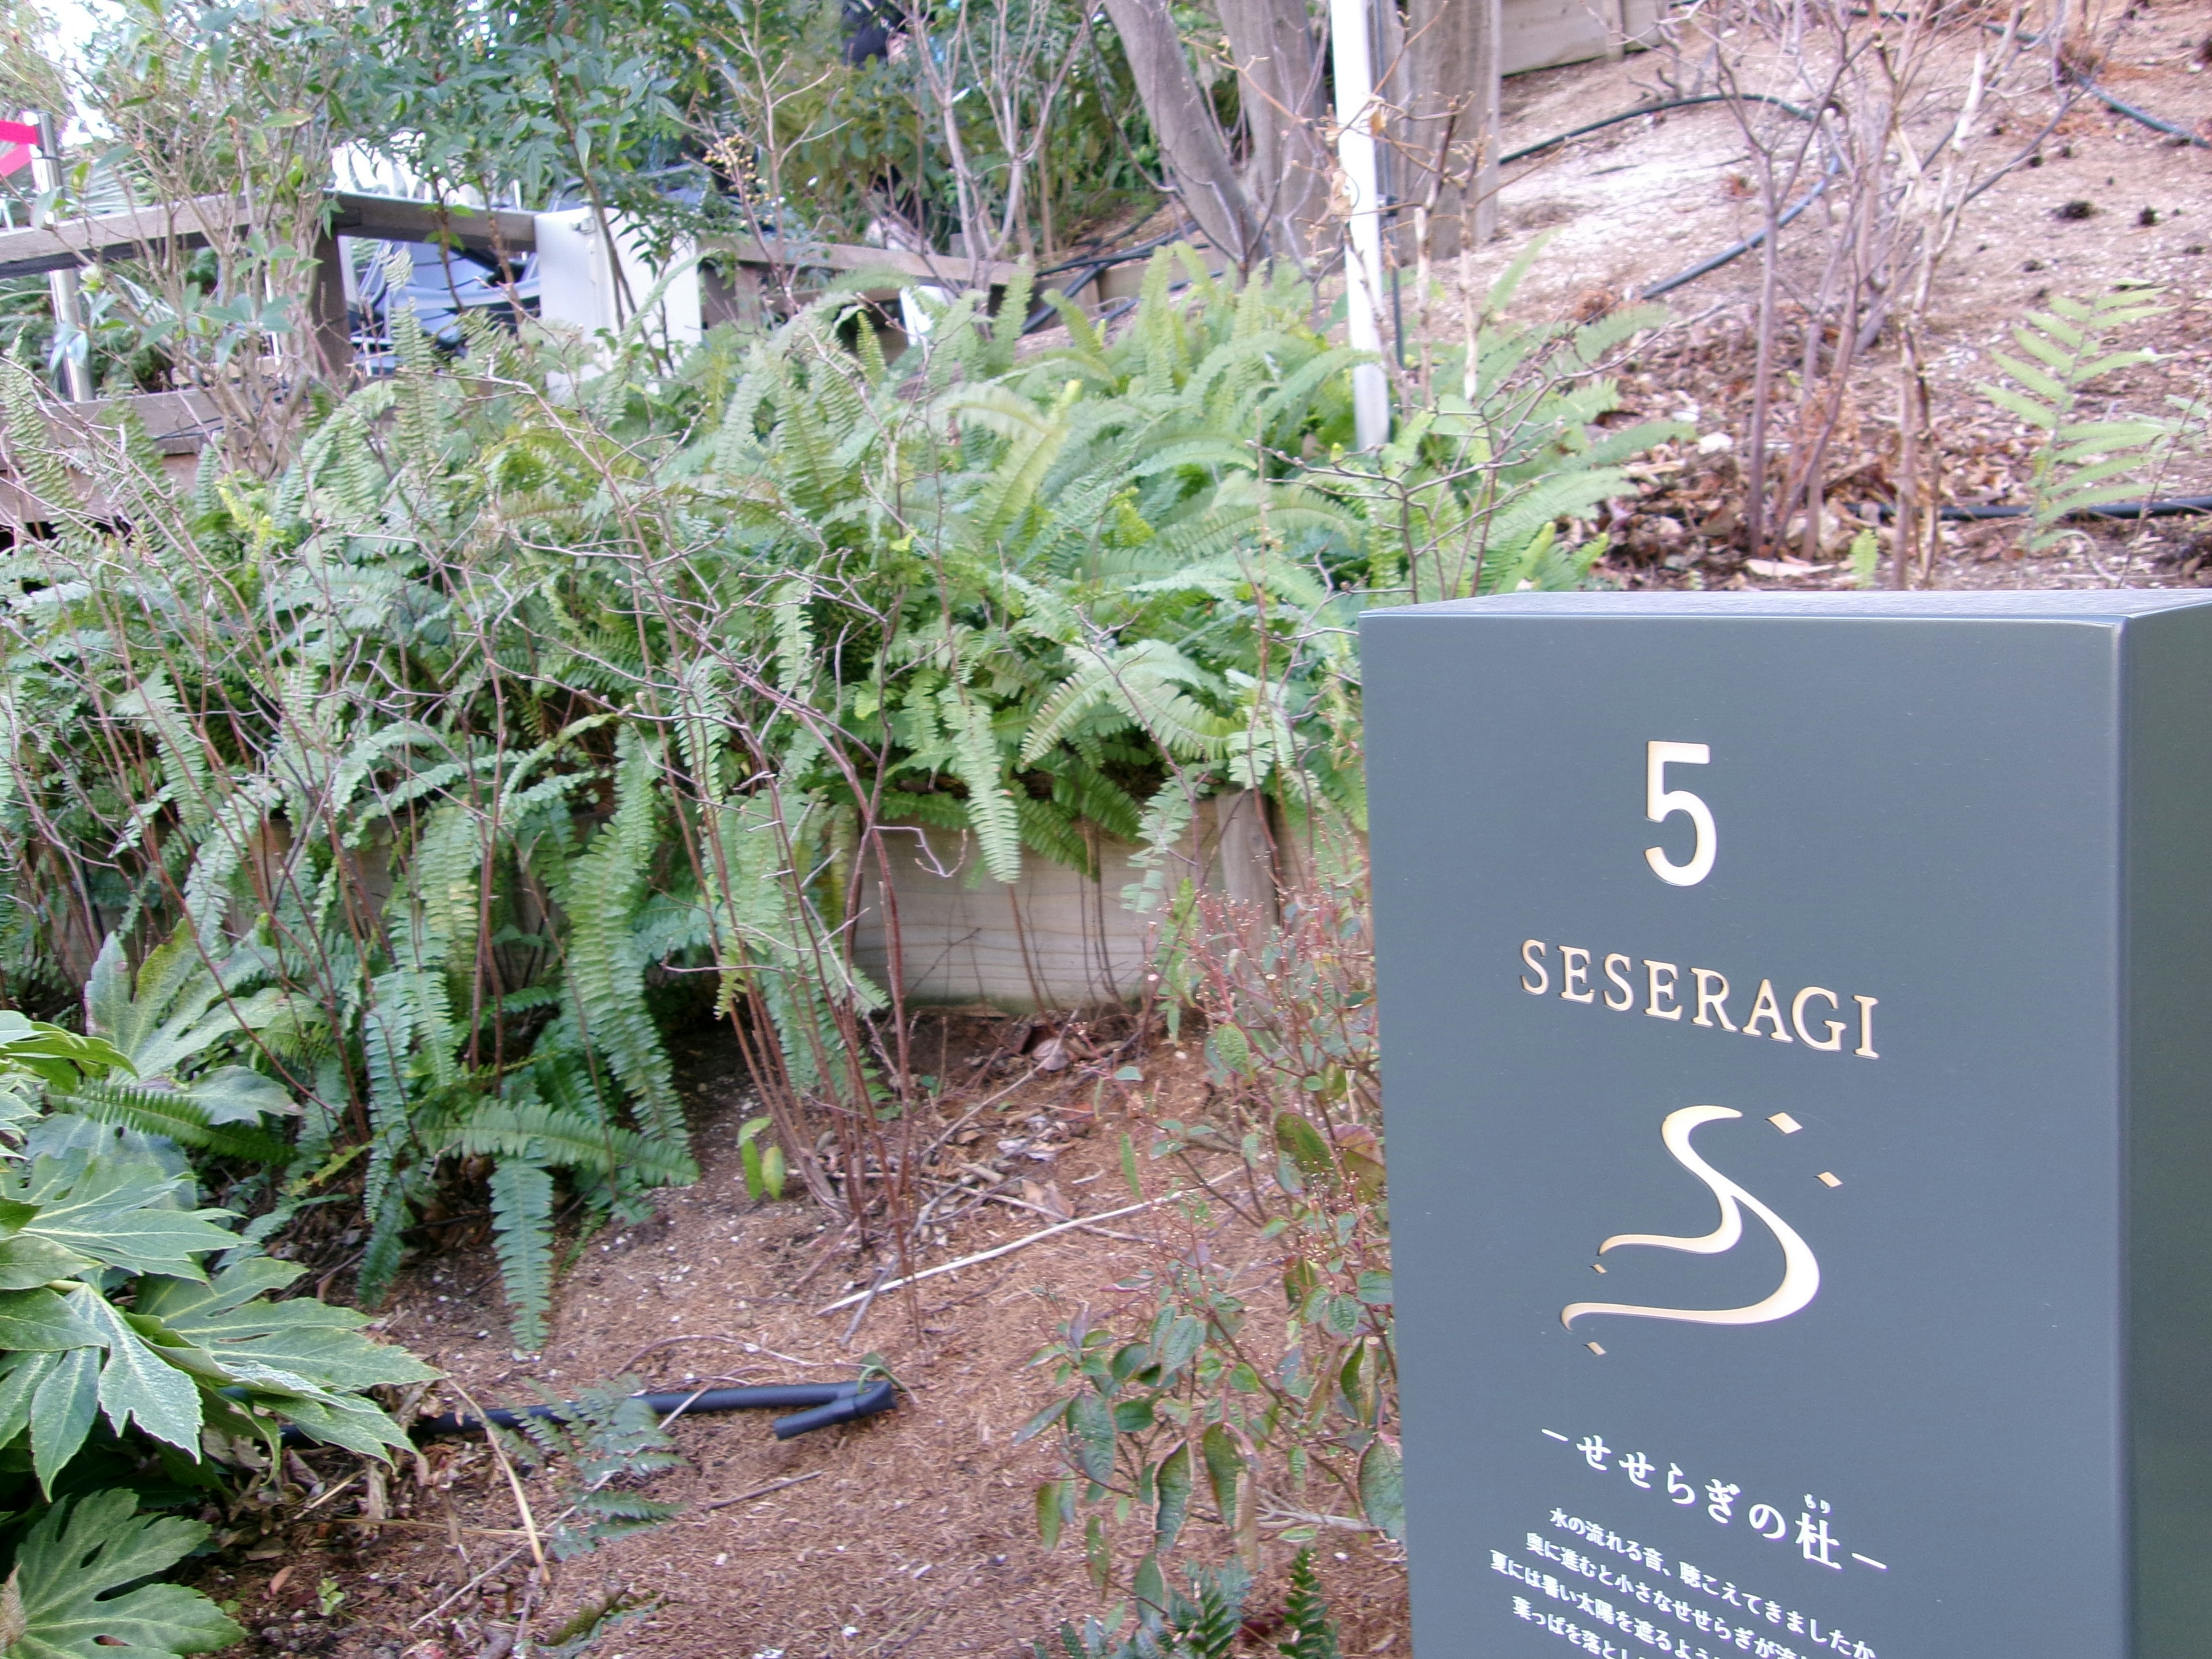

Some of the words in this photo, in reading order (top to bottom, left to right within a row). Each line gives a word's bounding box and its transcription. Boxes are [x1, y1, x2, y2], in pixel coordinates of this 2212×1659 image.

[1645, 740, 1717, 887] 5
[1521, 938, 1880, 1060] SESERAGI
[1525, 1532, 1808, 1659] 奥に進むと小さなせせらぎが流
